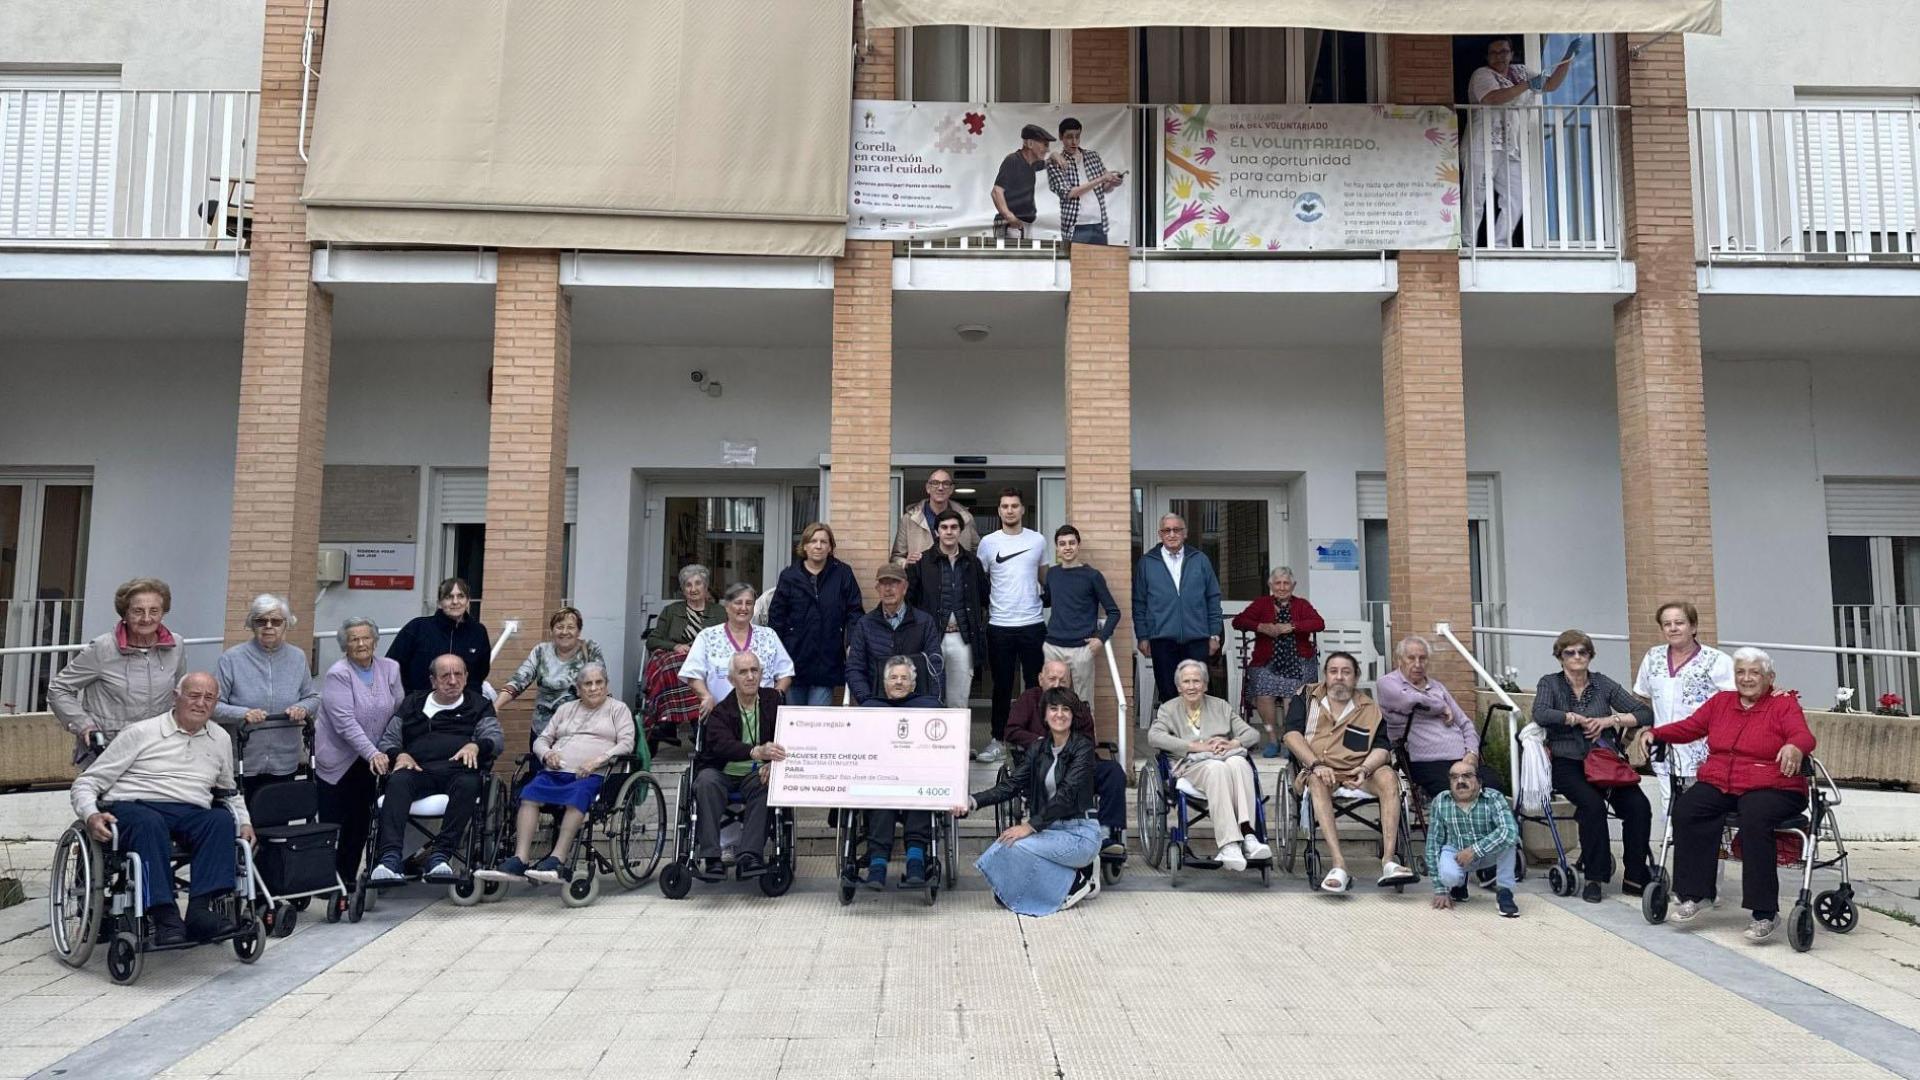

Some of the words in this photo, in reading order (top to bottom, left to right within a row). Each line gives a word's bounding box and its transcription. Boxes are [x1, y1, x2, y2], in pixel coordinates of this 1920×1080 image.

[1265, 122, 1328, 131] VOLUNTARIADO
[854, 141, 896, 152] Corella
[1230, 136, 1248, 148] EL
[854, 153, 868, 161] en
[870, 153, 923, 163] conexión
[1230, 155, 1258, 164] una
[1262, 154, 1352, 168] oportunidad
[854, 163, 880, 173] para
[883, 164, 893, 173] el
[896, 164, 943, 174] cuidado
[1230, 171, 1263, 183] para
[1266, 171, 1328, 183] cambiar
[1230, 186, 1242, 198] el
[1246, 187, 1297, 199] mundo
[795, 720, 822, 728] Cheque
[918, 787, 923, 796] 4
[926, 787, 951, 796] 400€
